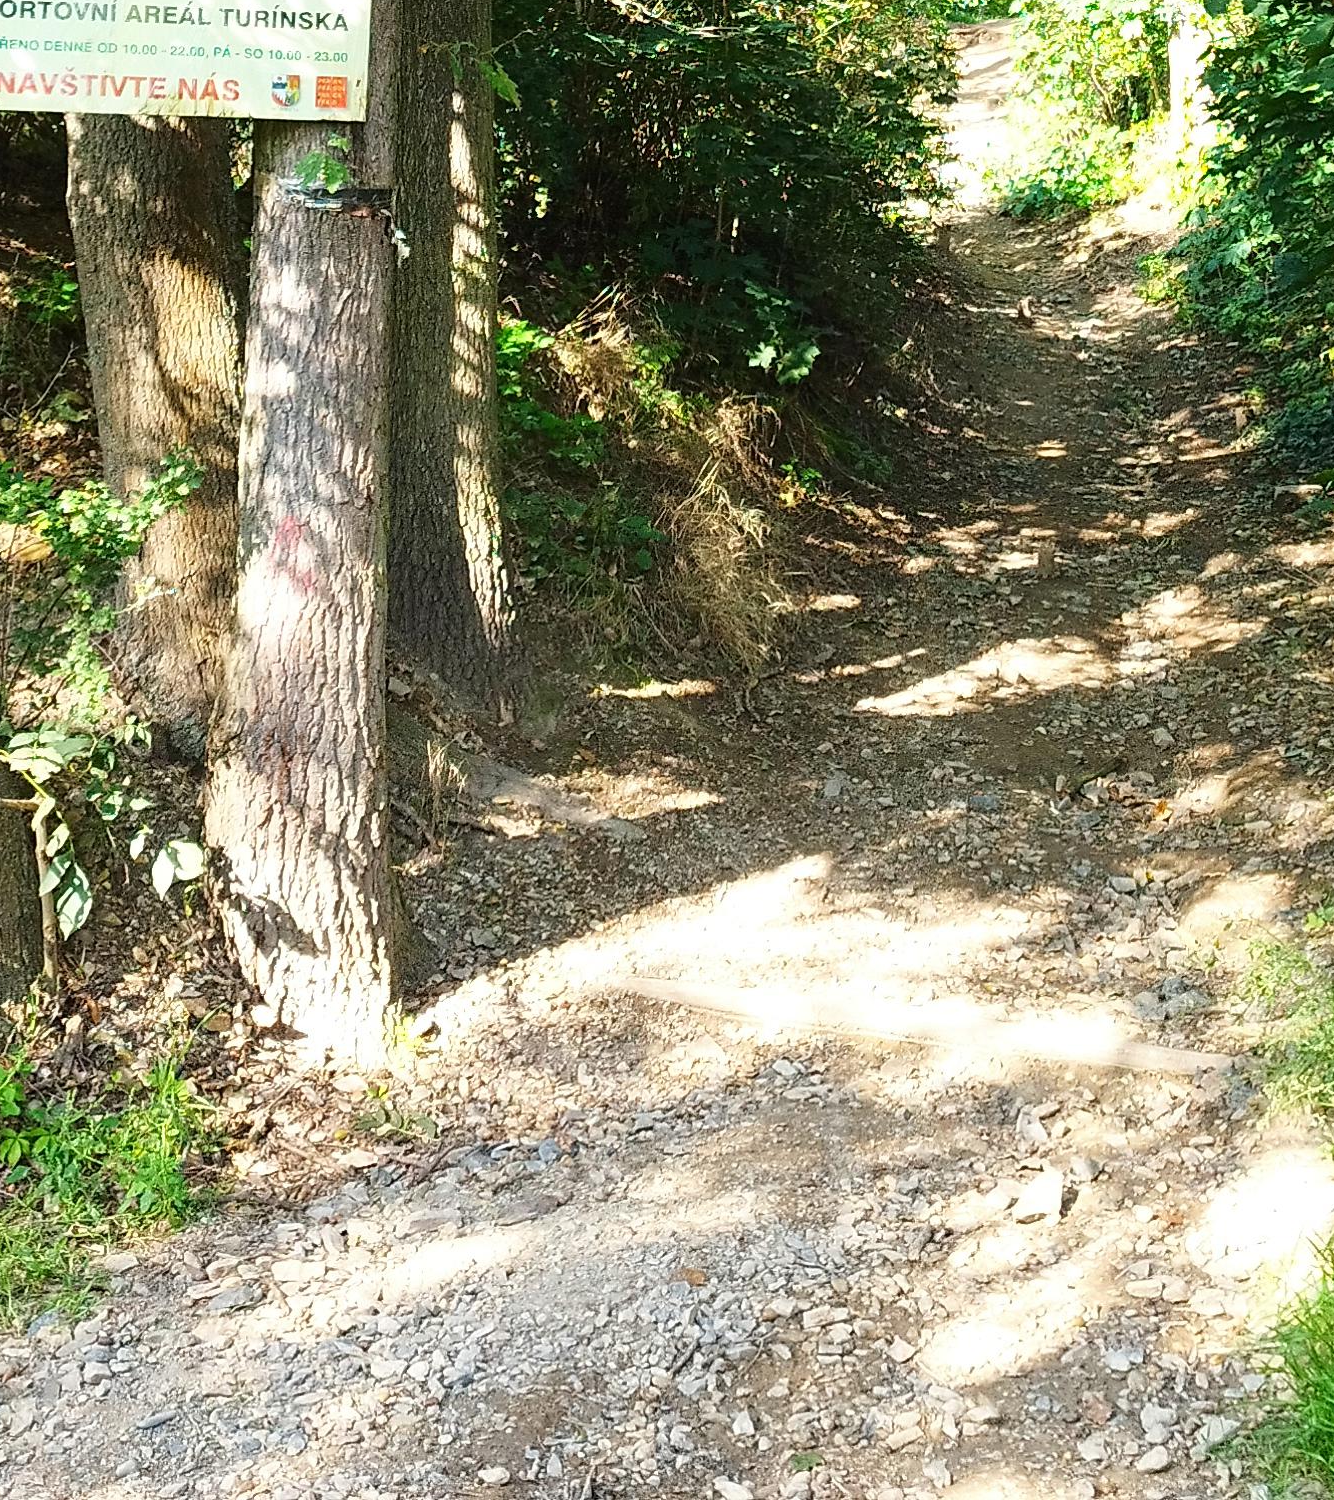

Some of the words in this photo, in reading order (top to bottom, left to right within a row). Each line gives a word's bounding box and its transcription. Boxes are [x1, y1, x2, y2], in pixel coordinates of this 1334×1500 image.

[124, 0, 212, 26] AREÁL
[97, 42, 118, 54] OD
[213, 44, 231, 58] PÁ
[244, 48, 264, 60] SO
[313, 51, 349, 63] 23.00
[178, 72, 241, 102] NÁS
